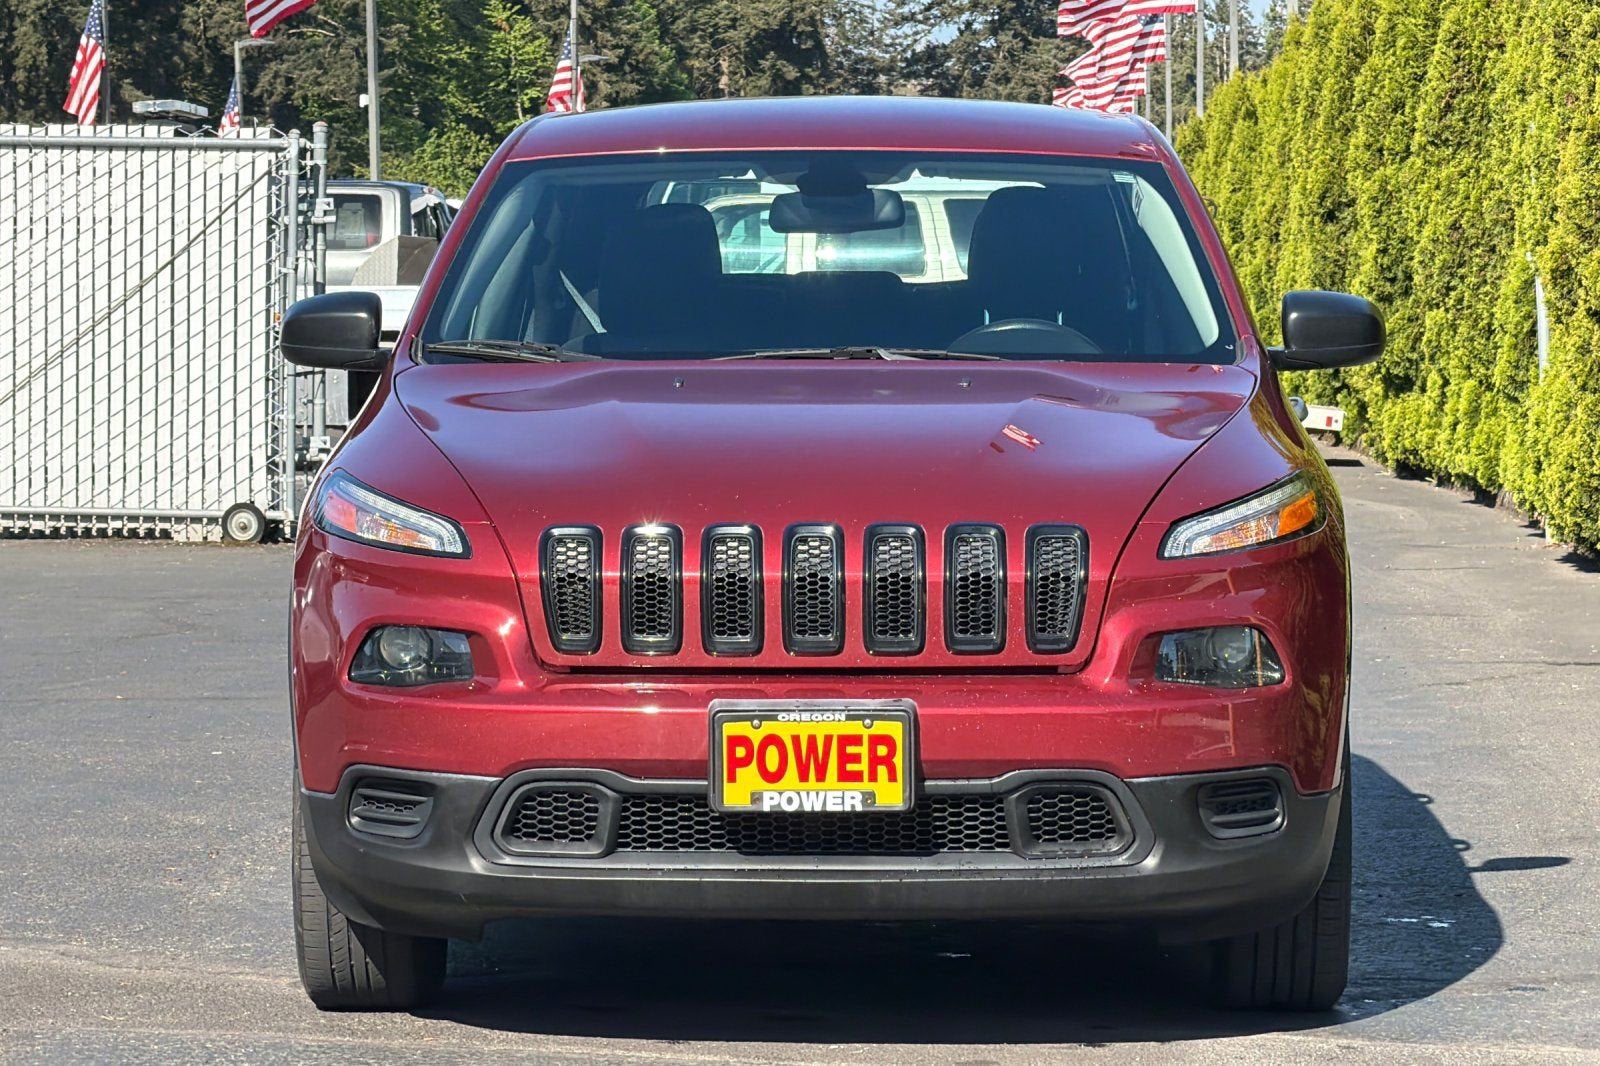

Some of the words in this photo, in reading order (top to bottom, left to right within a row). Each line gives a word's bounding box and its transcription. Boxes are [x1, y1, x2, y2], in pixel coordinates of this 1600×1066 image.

[777, 712, 847, 722] OREGON
[726, 733, 898, 784] POWER
[762, 791, 863, 812] POWER
